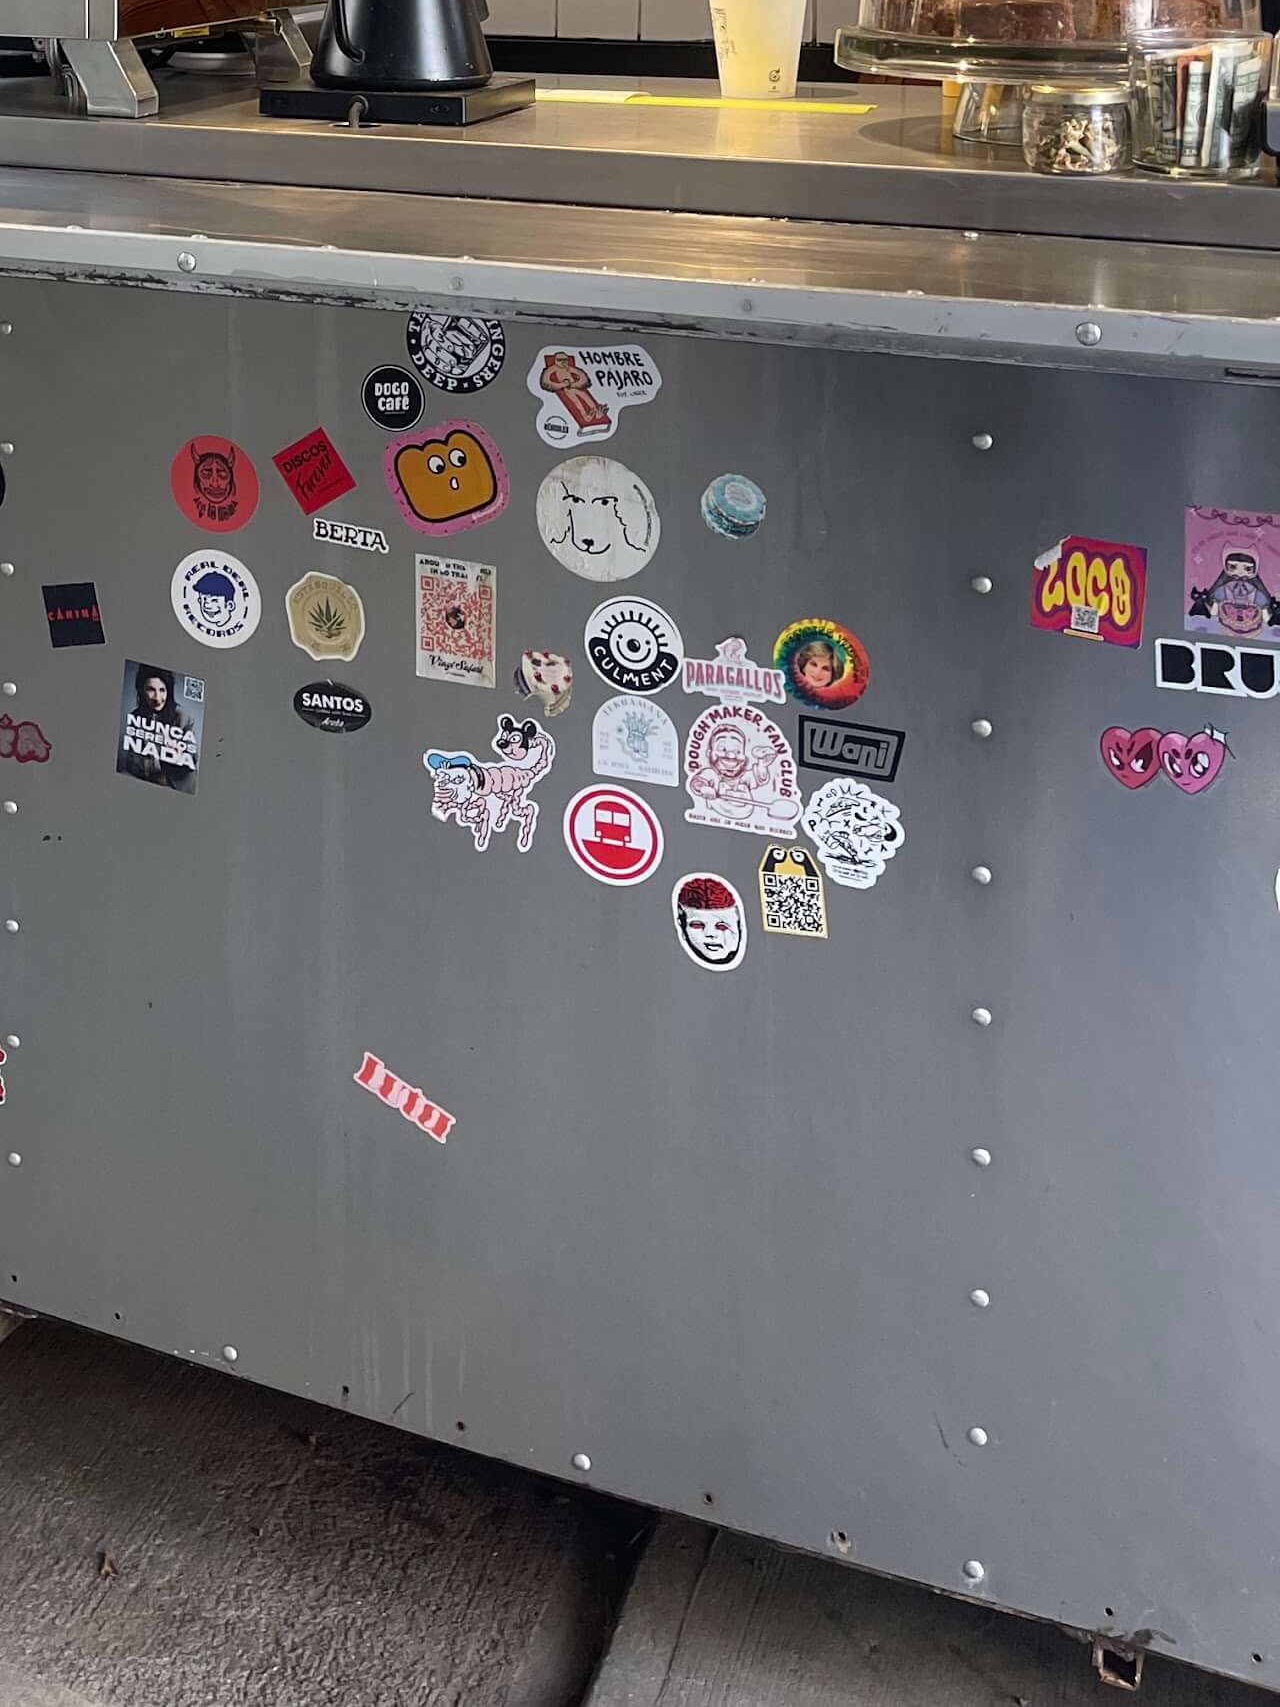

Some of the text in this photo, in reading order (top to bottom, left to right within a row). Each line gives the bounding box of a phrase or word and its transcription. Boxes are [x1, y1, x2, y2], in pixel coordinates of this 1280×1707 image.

[578, 350, 645, 367] HOMBRE
[375, 382, 410, 396] DOGO
[282, 440, 327, 474] DISCOS
[315, 521, 387, 551] BERTA
[185, 560, 219, 582] REAL
[183, 604, 245, 639] RECORDS
[687, 662, 782, 698] PARAGALLOS
[302, 692, 364, 712] SANTOS
[125, 728, 197, 753] SEREMOS
[126, 713, 197, 744] NUNCA
[124, 737, 196, 772] NADA
[764, 725, 788, 756] FAN
[779, 760, 794, 799] CLUB
[810, 728, 890, 770] Wani
